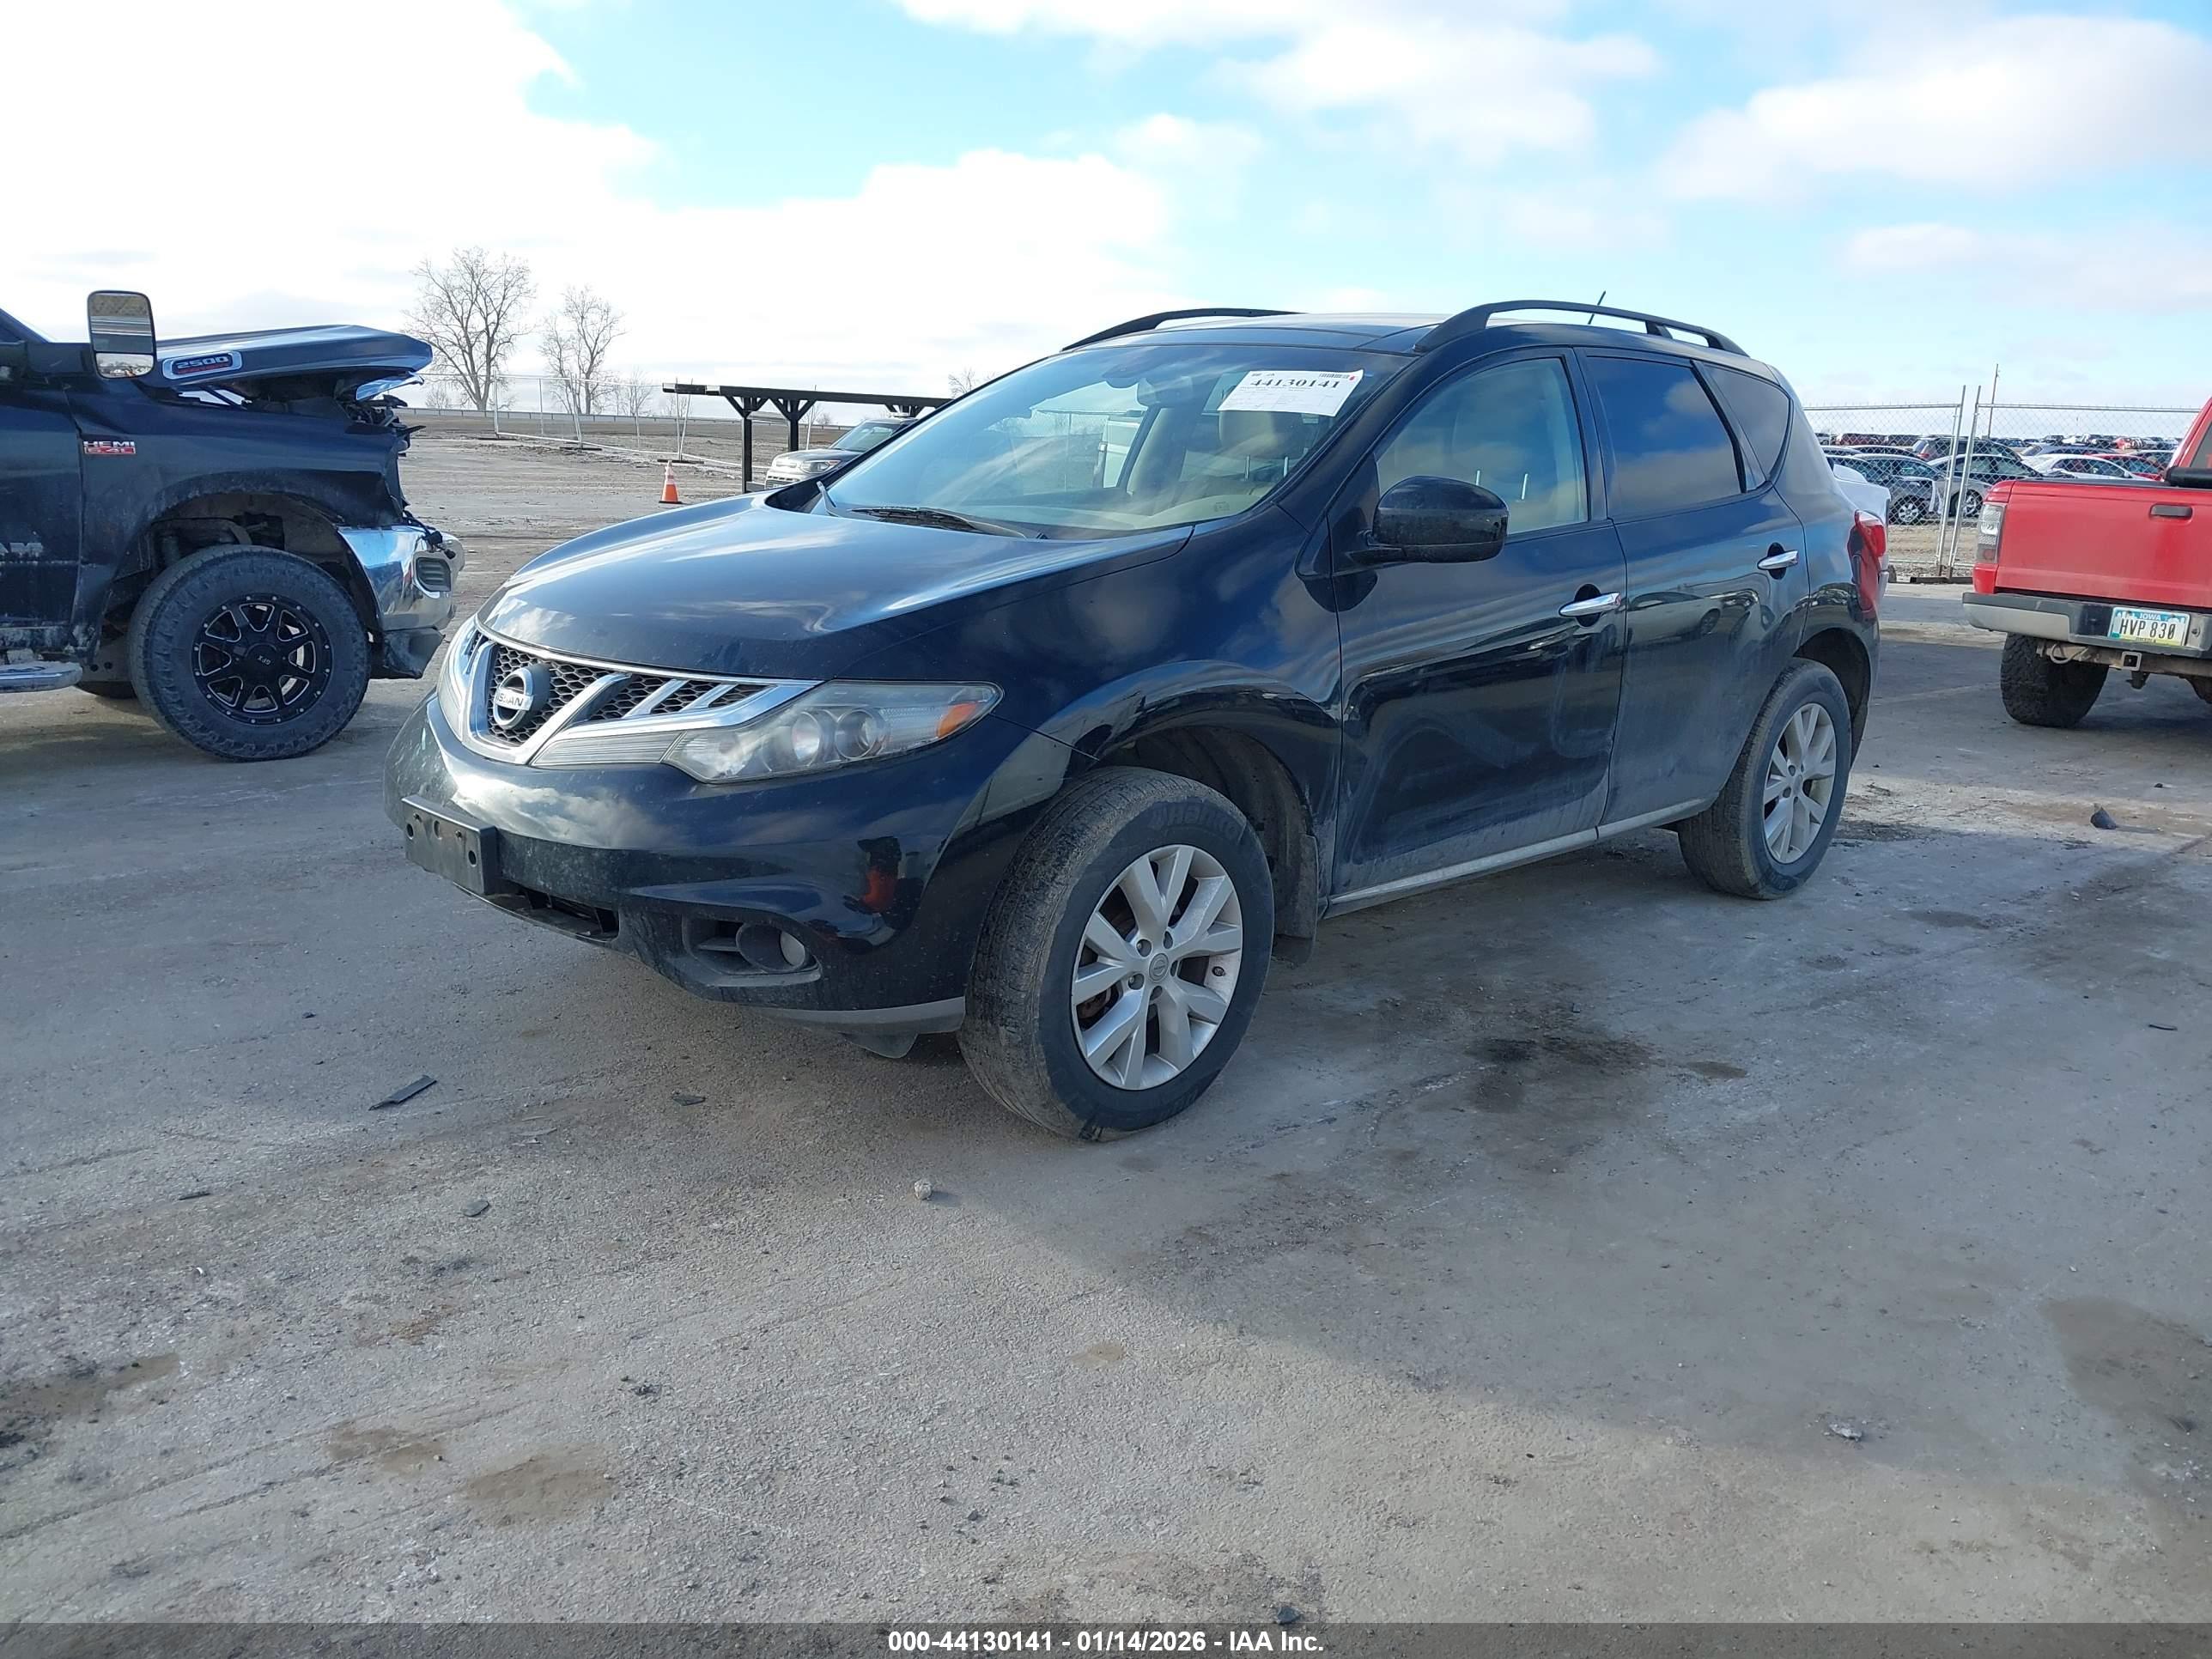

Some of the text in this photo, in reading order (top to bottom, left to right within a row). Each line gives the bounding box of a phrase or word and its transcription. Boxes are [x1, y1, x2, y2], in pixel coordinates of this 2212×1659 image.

[176, 356, 228, 369] 2500
[1250, 379, 1340, 388] 44130141
[2139, 612, 2161, 621] IOWA
[2119, 618, 2176, 640] HVP 830
